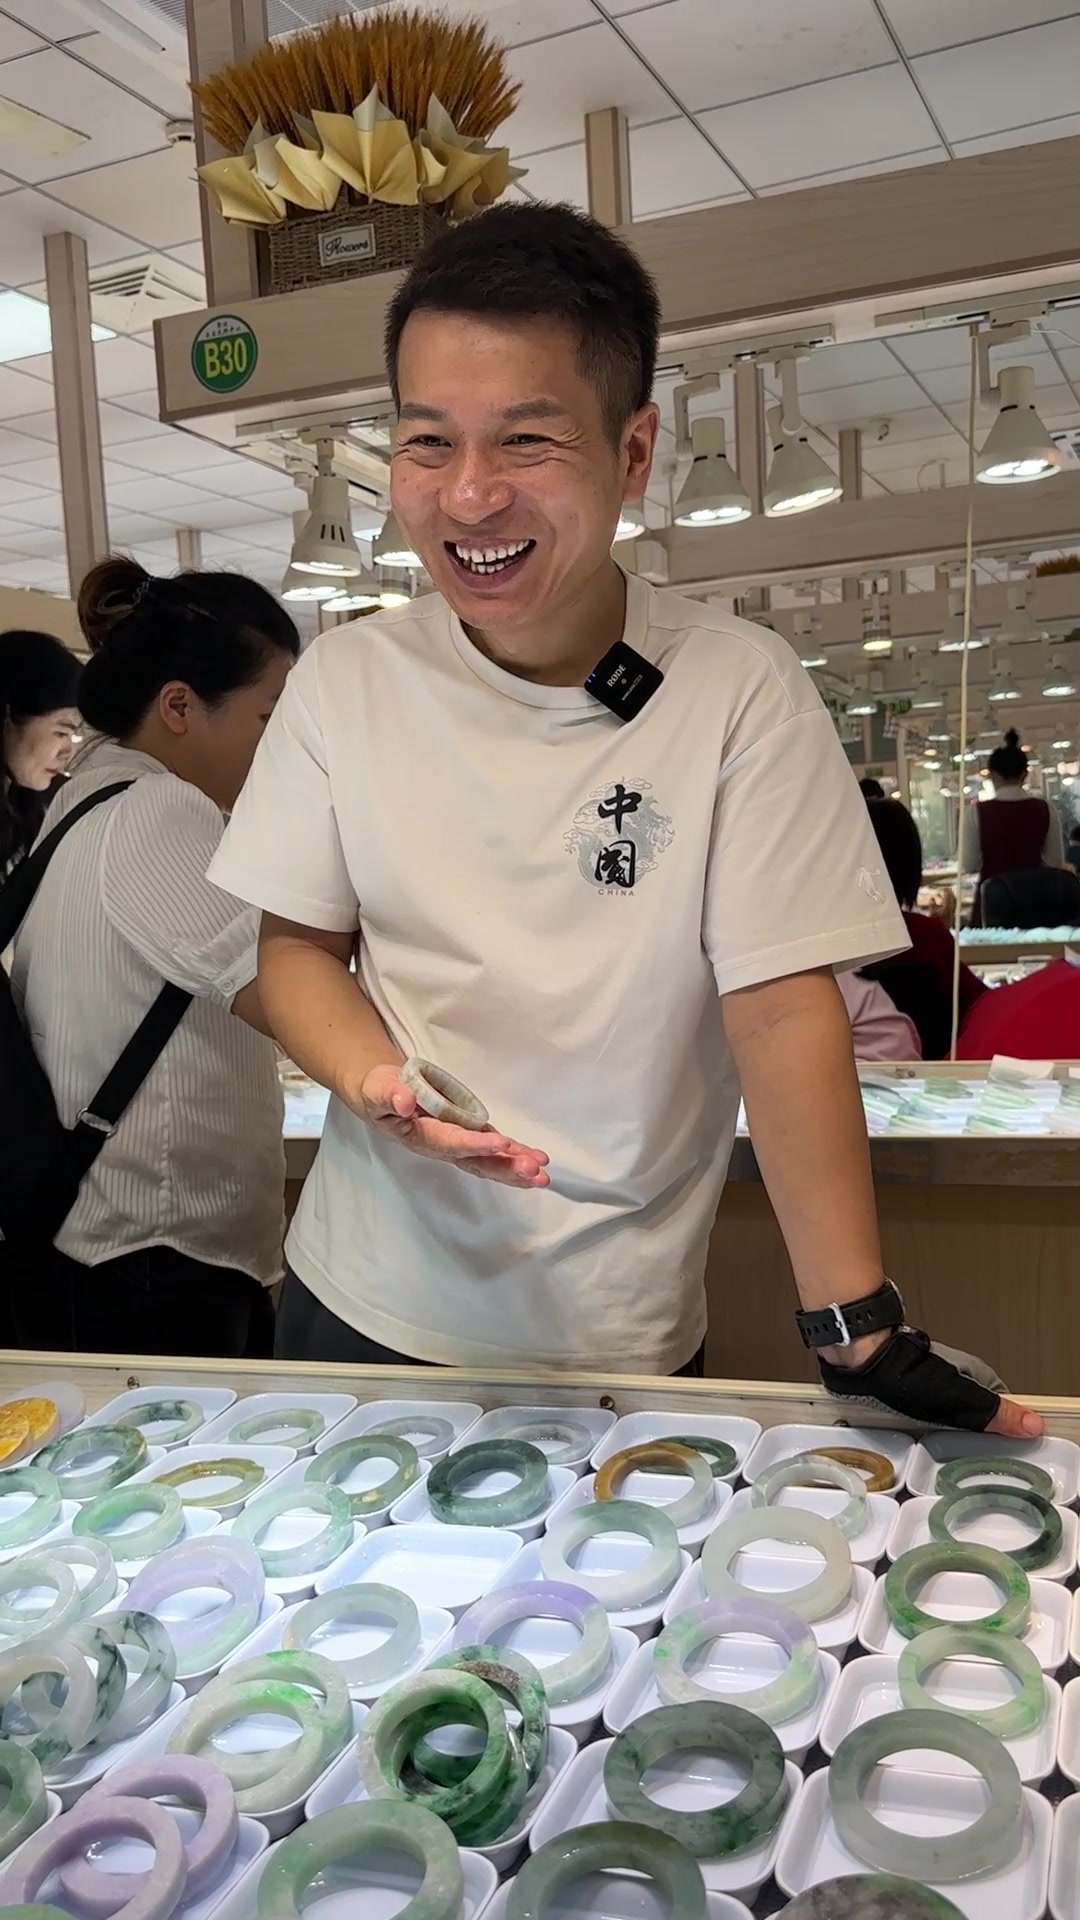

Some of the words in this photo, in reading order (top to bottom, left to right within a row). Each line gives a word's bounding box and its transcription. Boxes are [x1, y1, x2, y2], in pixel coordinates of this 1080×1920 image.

[325, 236, 369, 257] Flowers
[204, 338, 247, 378] B30
[598, 888, 635, 896] CHINA
